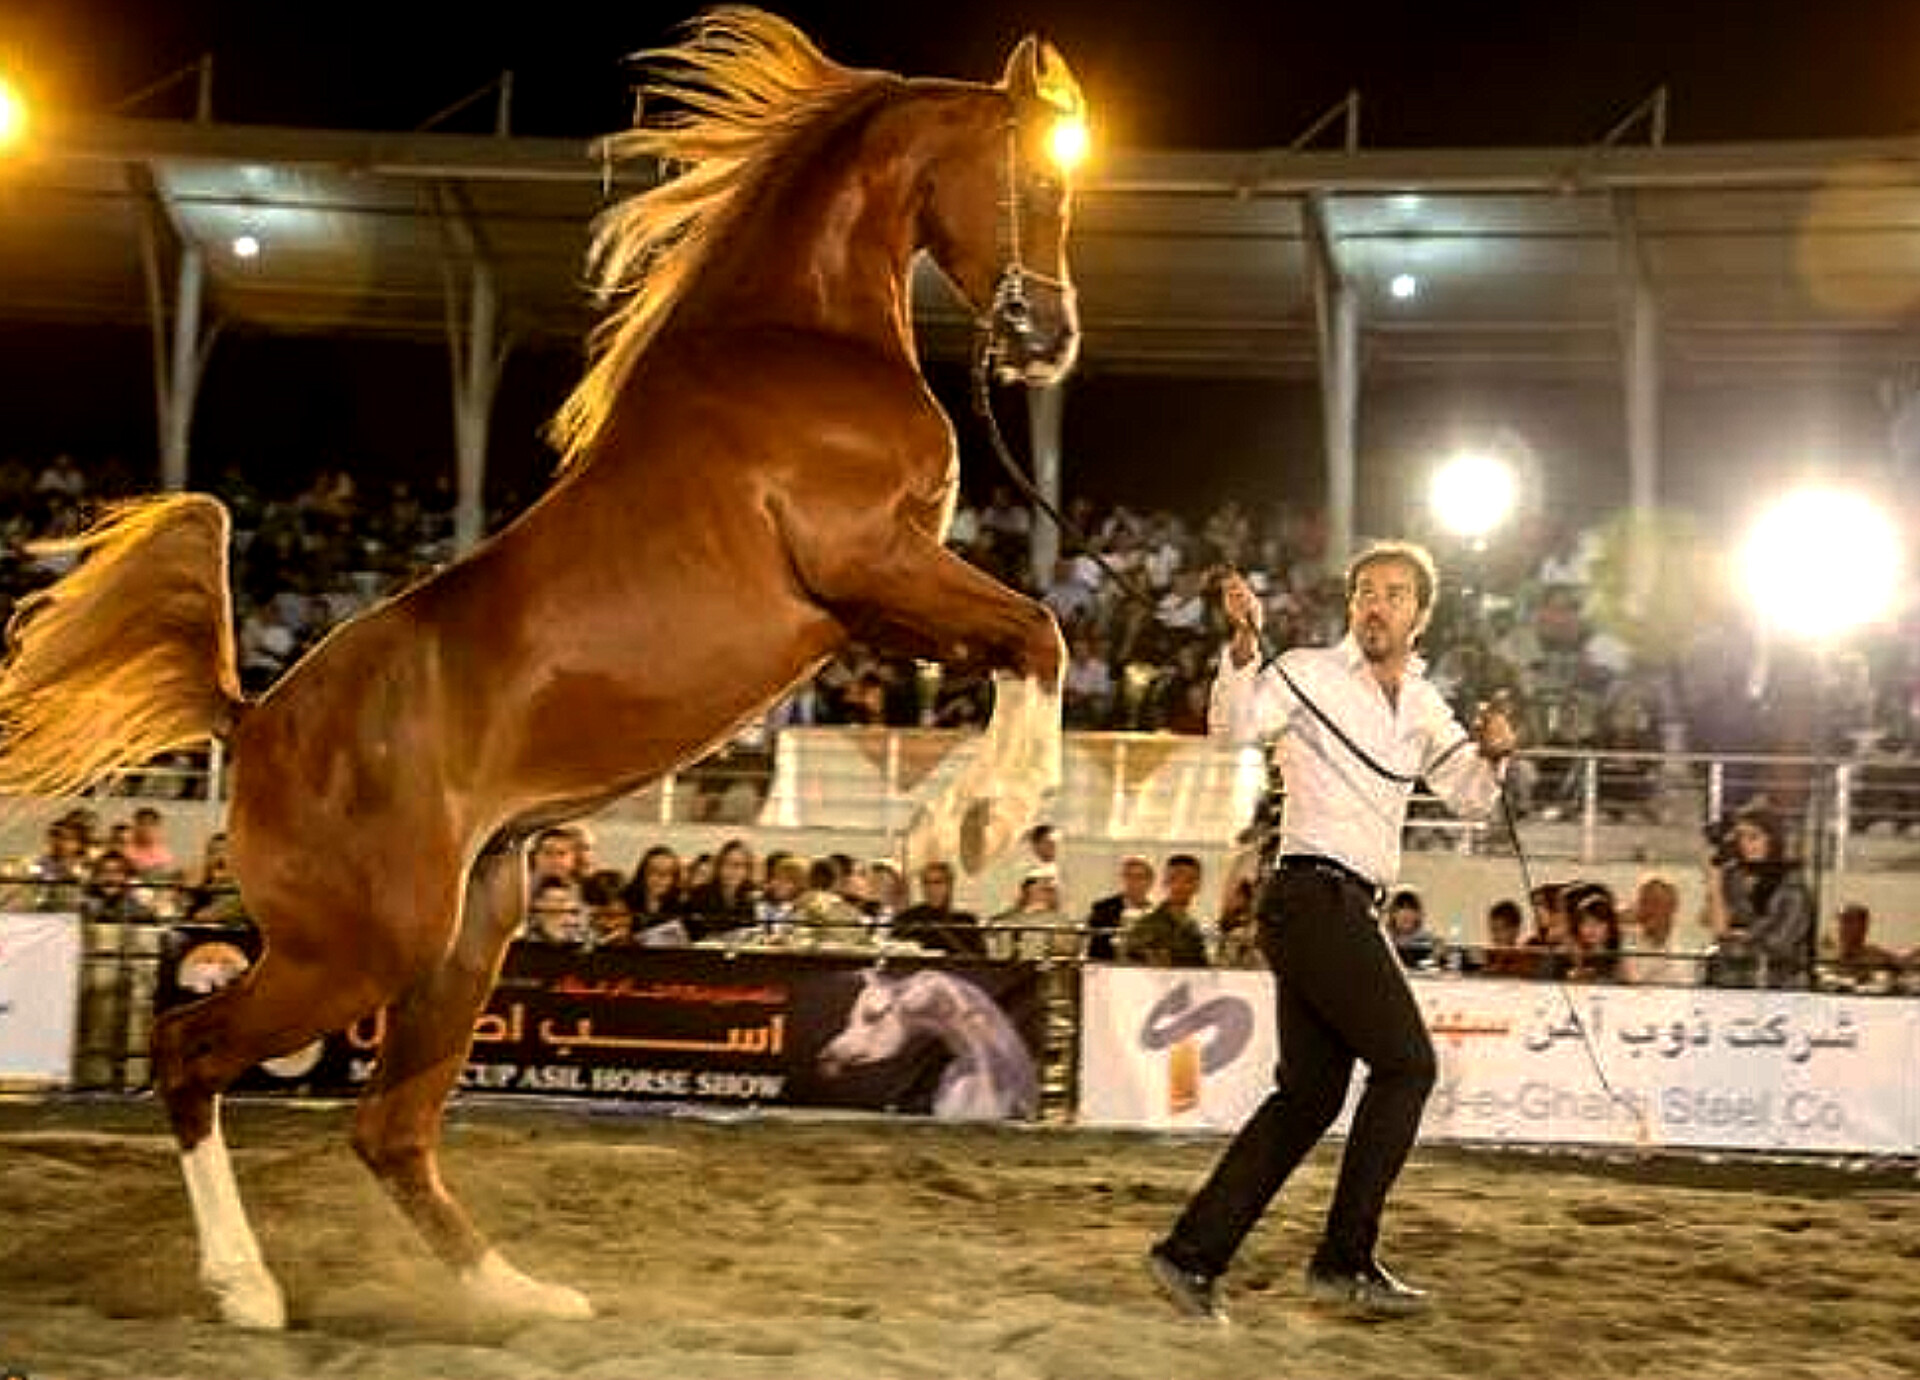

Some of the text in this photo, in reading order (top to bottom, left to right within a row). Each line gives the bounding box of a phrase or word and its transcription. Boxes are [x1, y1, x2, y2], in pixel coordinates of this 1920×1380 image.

[539, 1013, 784, 1056] اسب
[517, 1065, 587, 1090] ASIL
[592, 1067, 693, 1094] HORSE
[697, 1071, 787, 1098] SHOW
